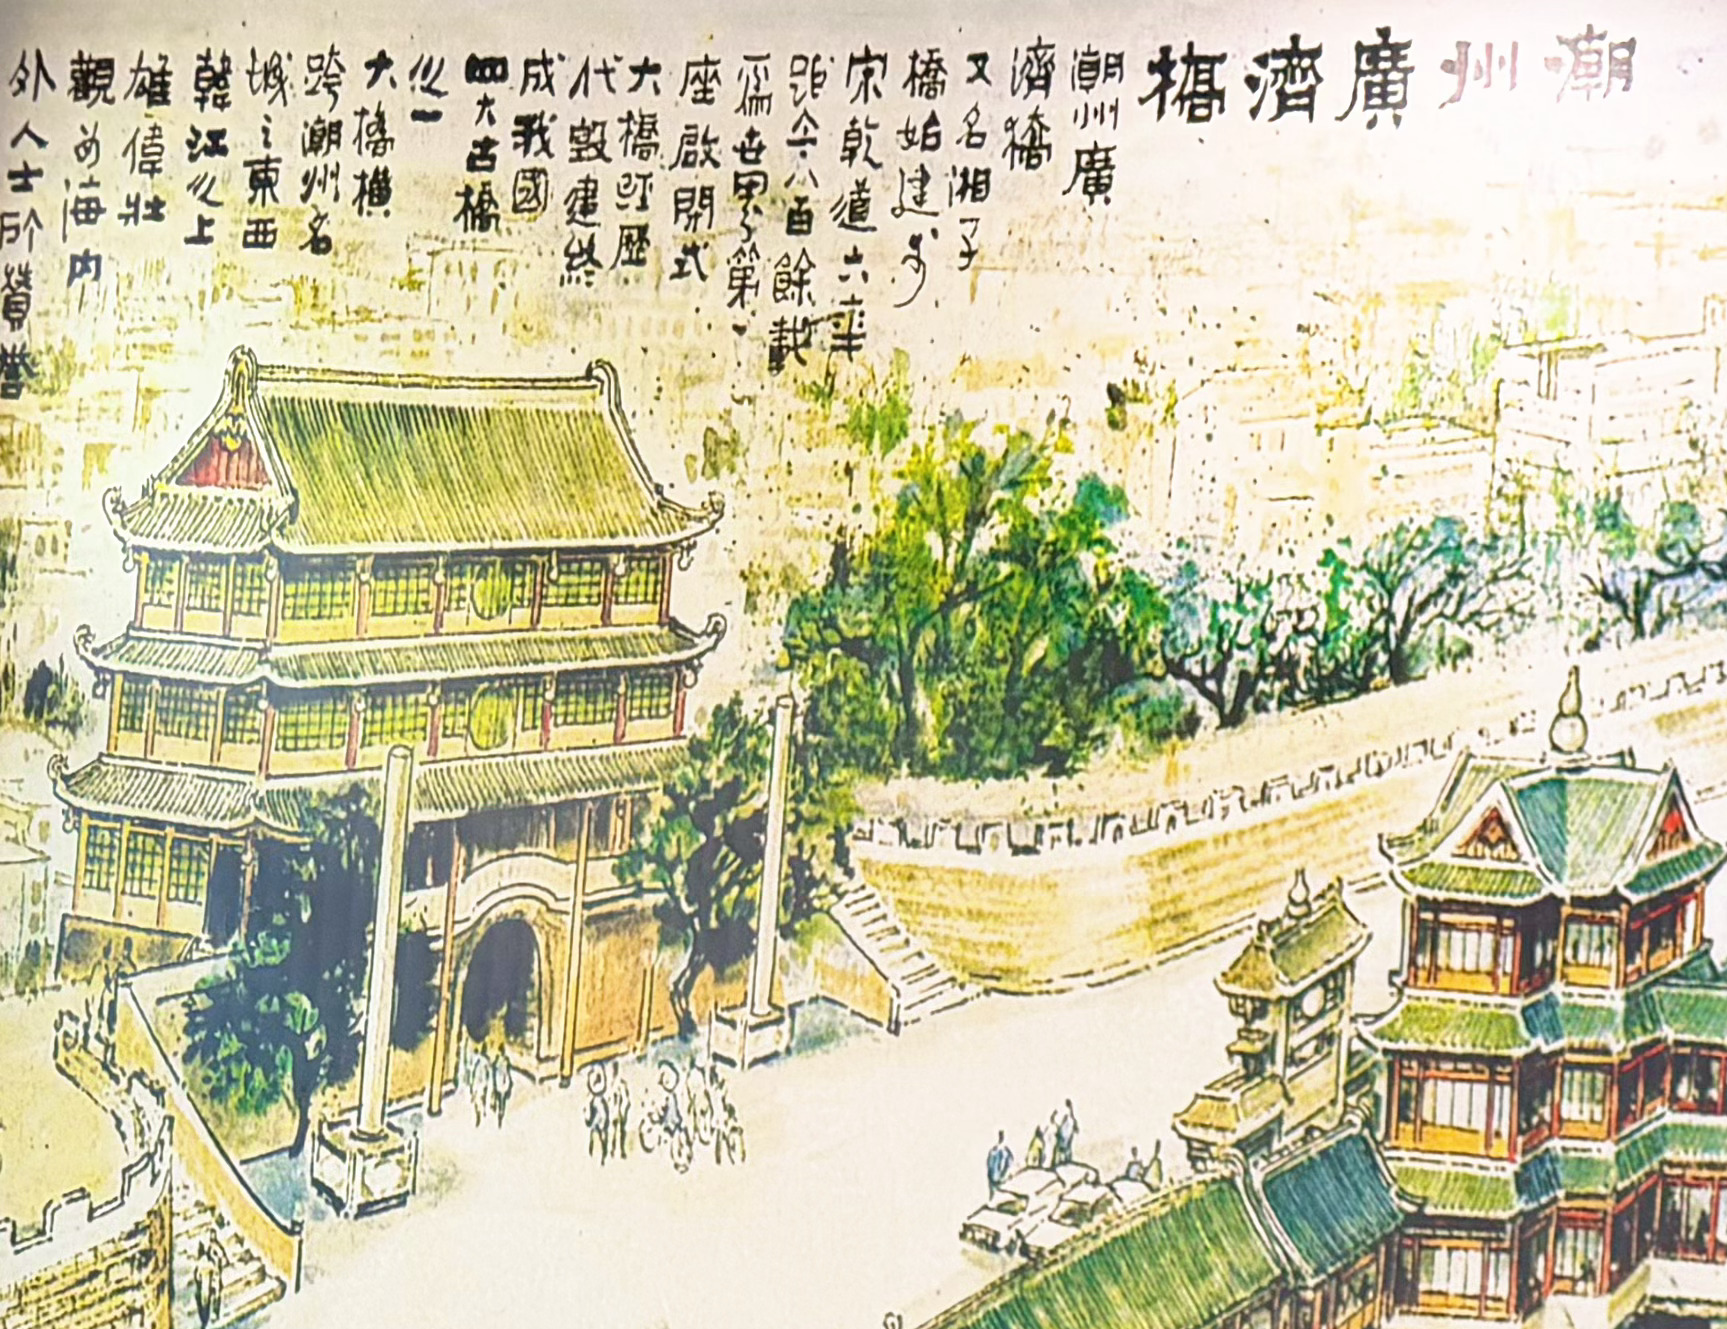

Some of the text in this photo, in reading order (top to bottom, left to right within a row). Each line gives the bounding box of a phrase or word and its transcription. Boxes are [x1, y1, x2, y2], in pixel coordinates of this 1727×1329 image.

[117, 49, 174, 228] 雄偉壯
[183, 47, 233, 246] 韓江之上
[452, 53, 509, 234] 四大古橋
[511, 48, 566, 214] 成我國
[1000, 35, 1055, 171] 濟橋
[1062, 43, 1125, 206] 潮州廣
